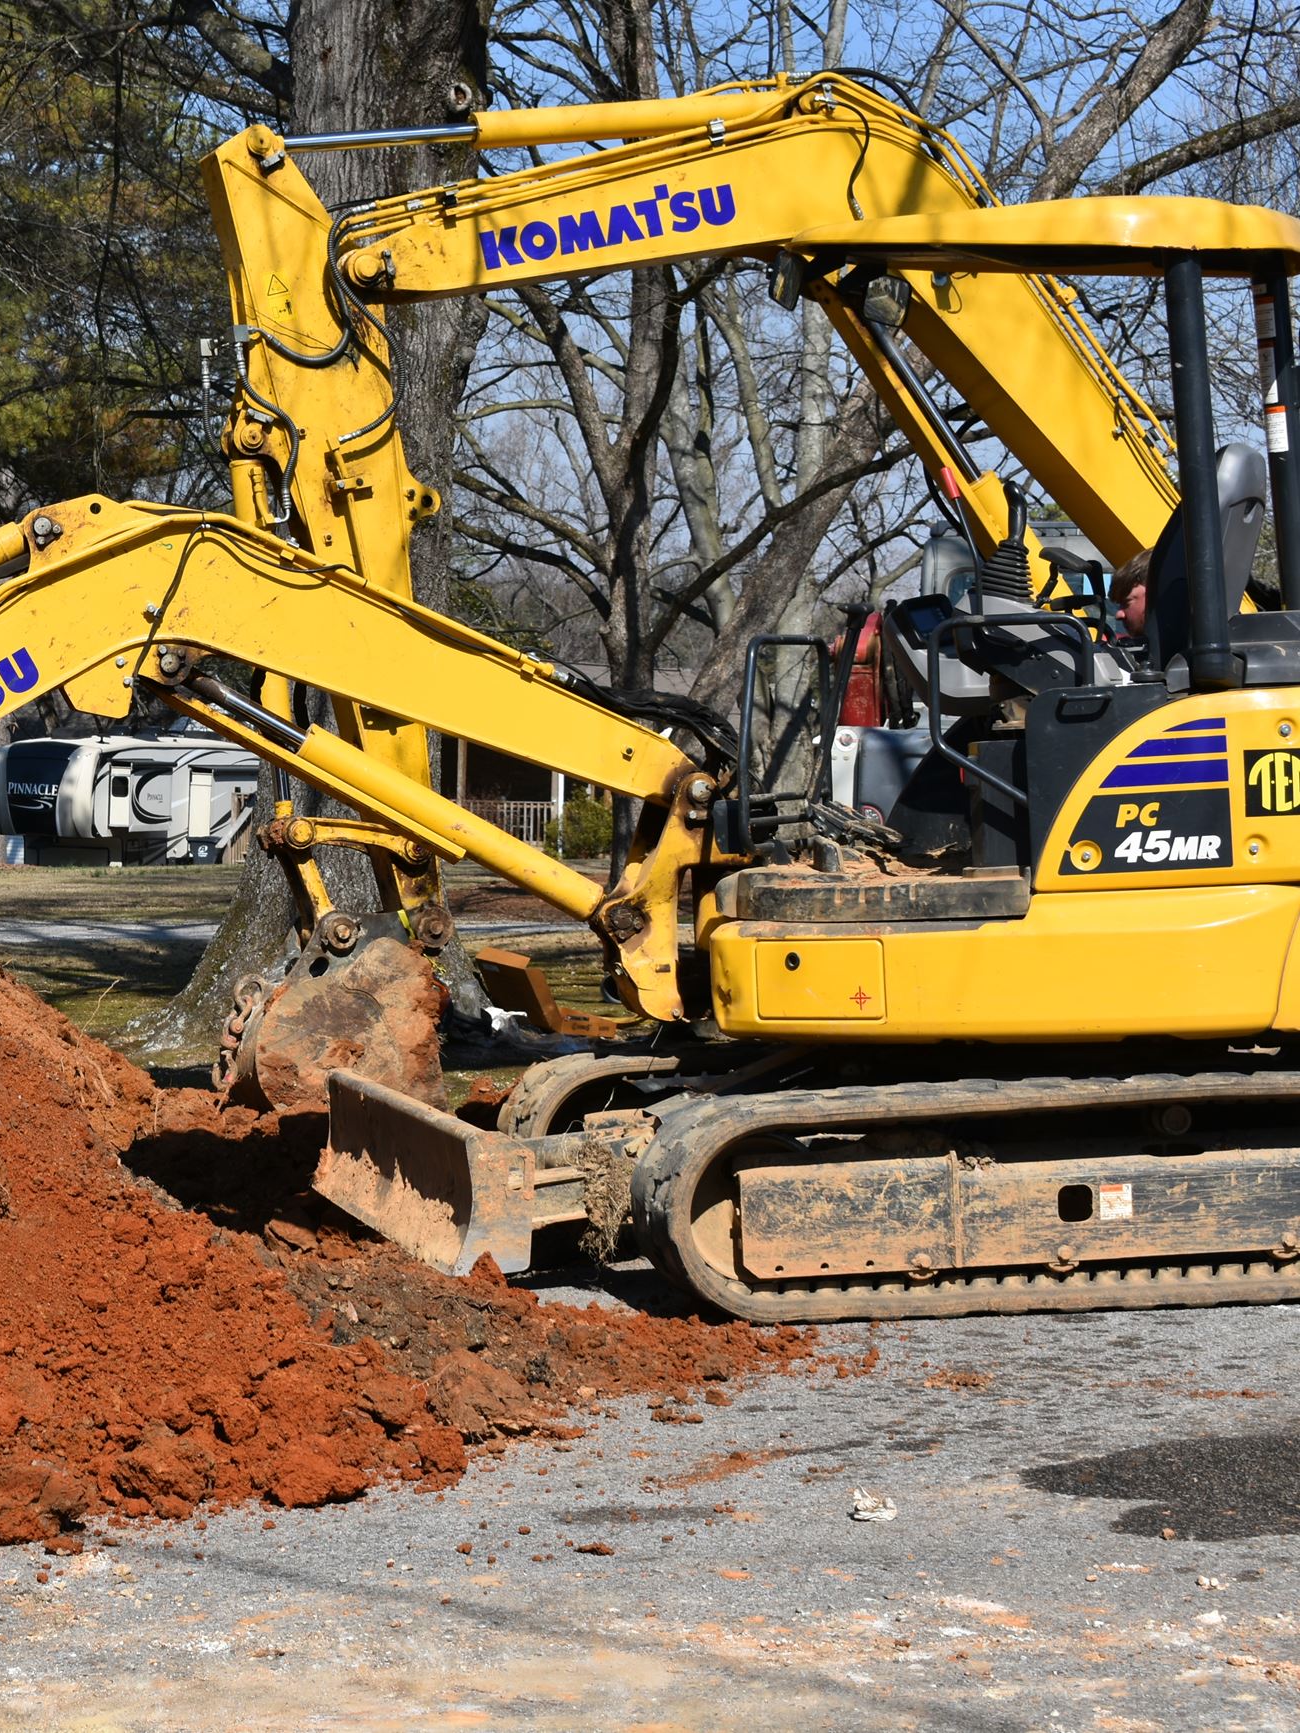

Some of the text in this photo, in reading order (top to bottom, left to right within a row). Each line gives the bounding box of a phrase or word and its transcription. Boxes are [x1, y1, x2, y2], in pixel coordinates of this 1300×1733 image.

[478, 183, 736, 270] KOMATSU
[7, 781, 59, 796] PINNACLE
[1115, 802, 1160, 829] PC
[1114, 830, 1221, 863] 45MR
